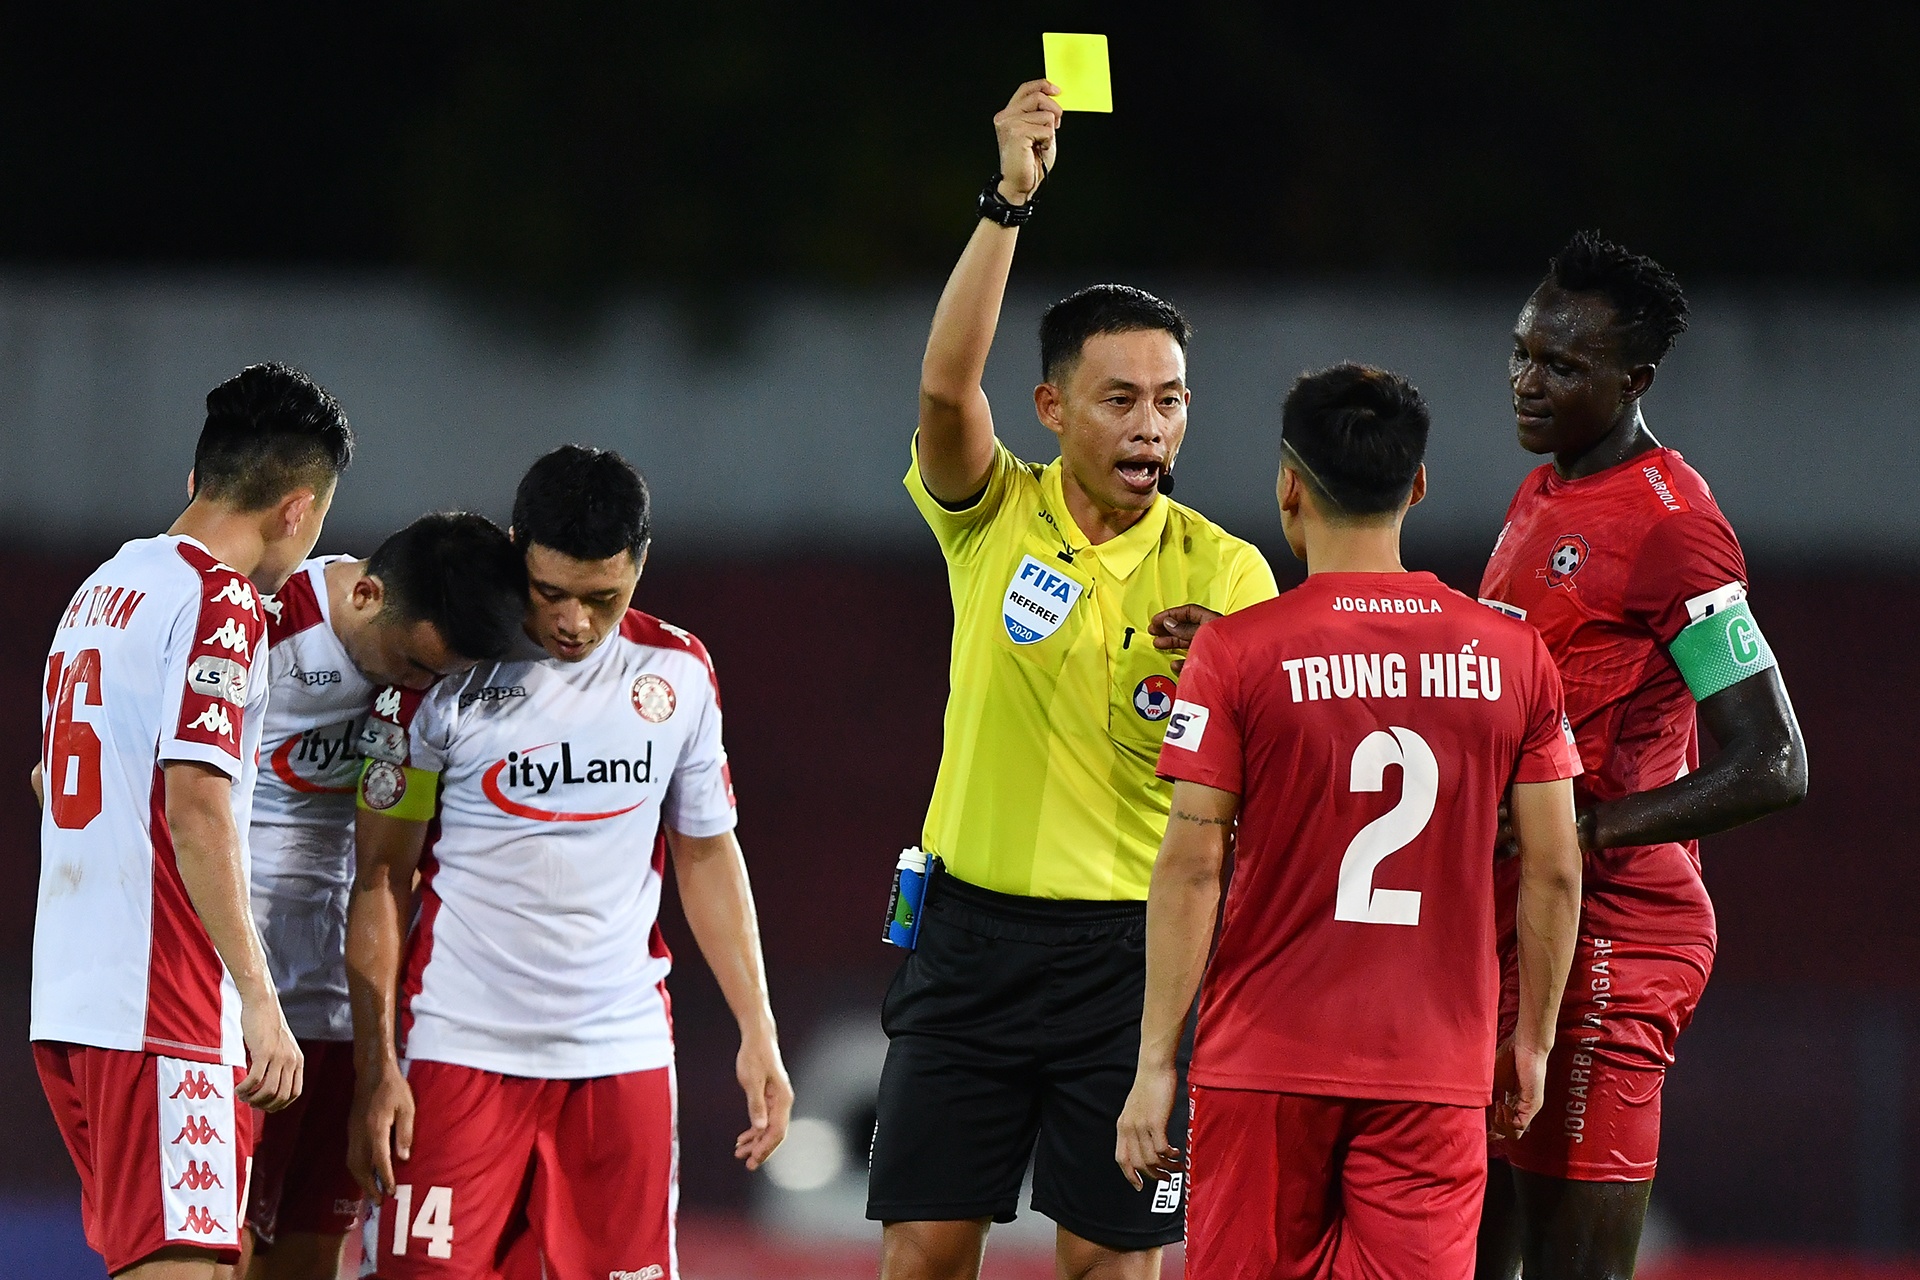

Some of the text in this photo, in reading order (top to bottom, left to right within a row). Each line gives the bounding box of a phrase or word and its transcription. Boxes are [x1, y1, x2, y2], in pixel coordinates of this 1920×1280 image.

[1020, 563, 1070, 604] FIFA
[1009, 591, 1059, 625] REFEREE
[1332, 596, 1443, 614] JOGARBOLA
[1009, 622, 1033, 641] 2020
[1728, 616, 1759, 664] C
[290, 664, 341, 686] Kppa
[1282, 639, 1502, 703] TRUNG HIẾU
[459, 685, 526, 708] Kappa
[1147, 707, 1161, 716] VFF
[46, 647, 103, 831] 16
[1334, 726, 1440, 926] 2
[392, 1184, 455, 1260] 14
